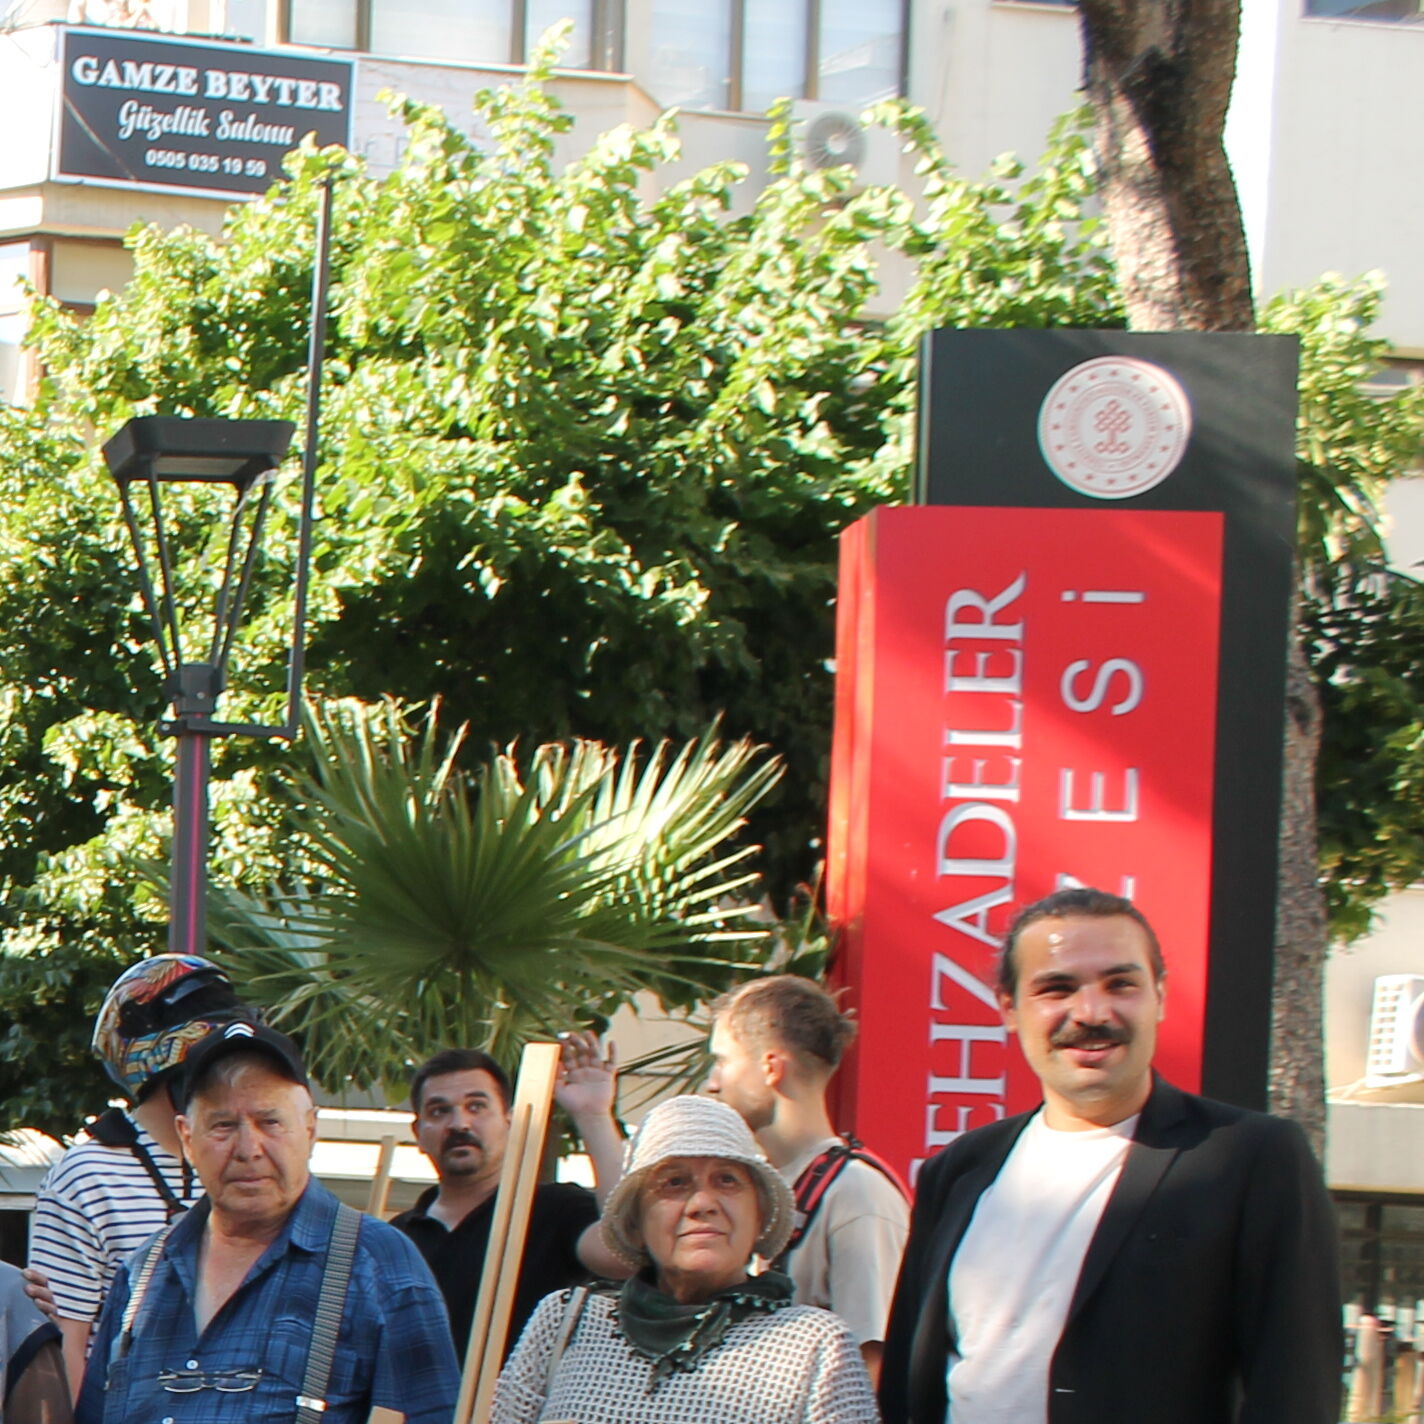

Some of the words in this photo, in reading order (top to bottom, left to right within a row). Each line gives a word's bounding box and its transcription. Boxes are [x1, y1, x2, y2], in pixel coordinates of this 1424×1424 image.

[71, 55, 199, 96] GAMZE
[203, 69, 344, 112] BEYTER
[117, 100, 212, 141] Güzellik
[215, 109, 295, 146] Salonu
[145, 148, 186, 169] 0505
[909, 569, 1029, 1188] EHZADELER
